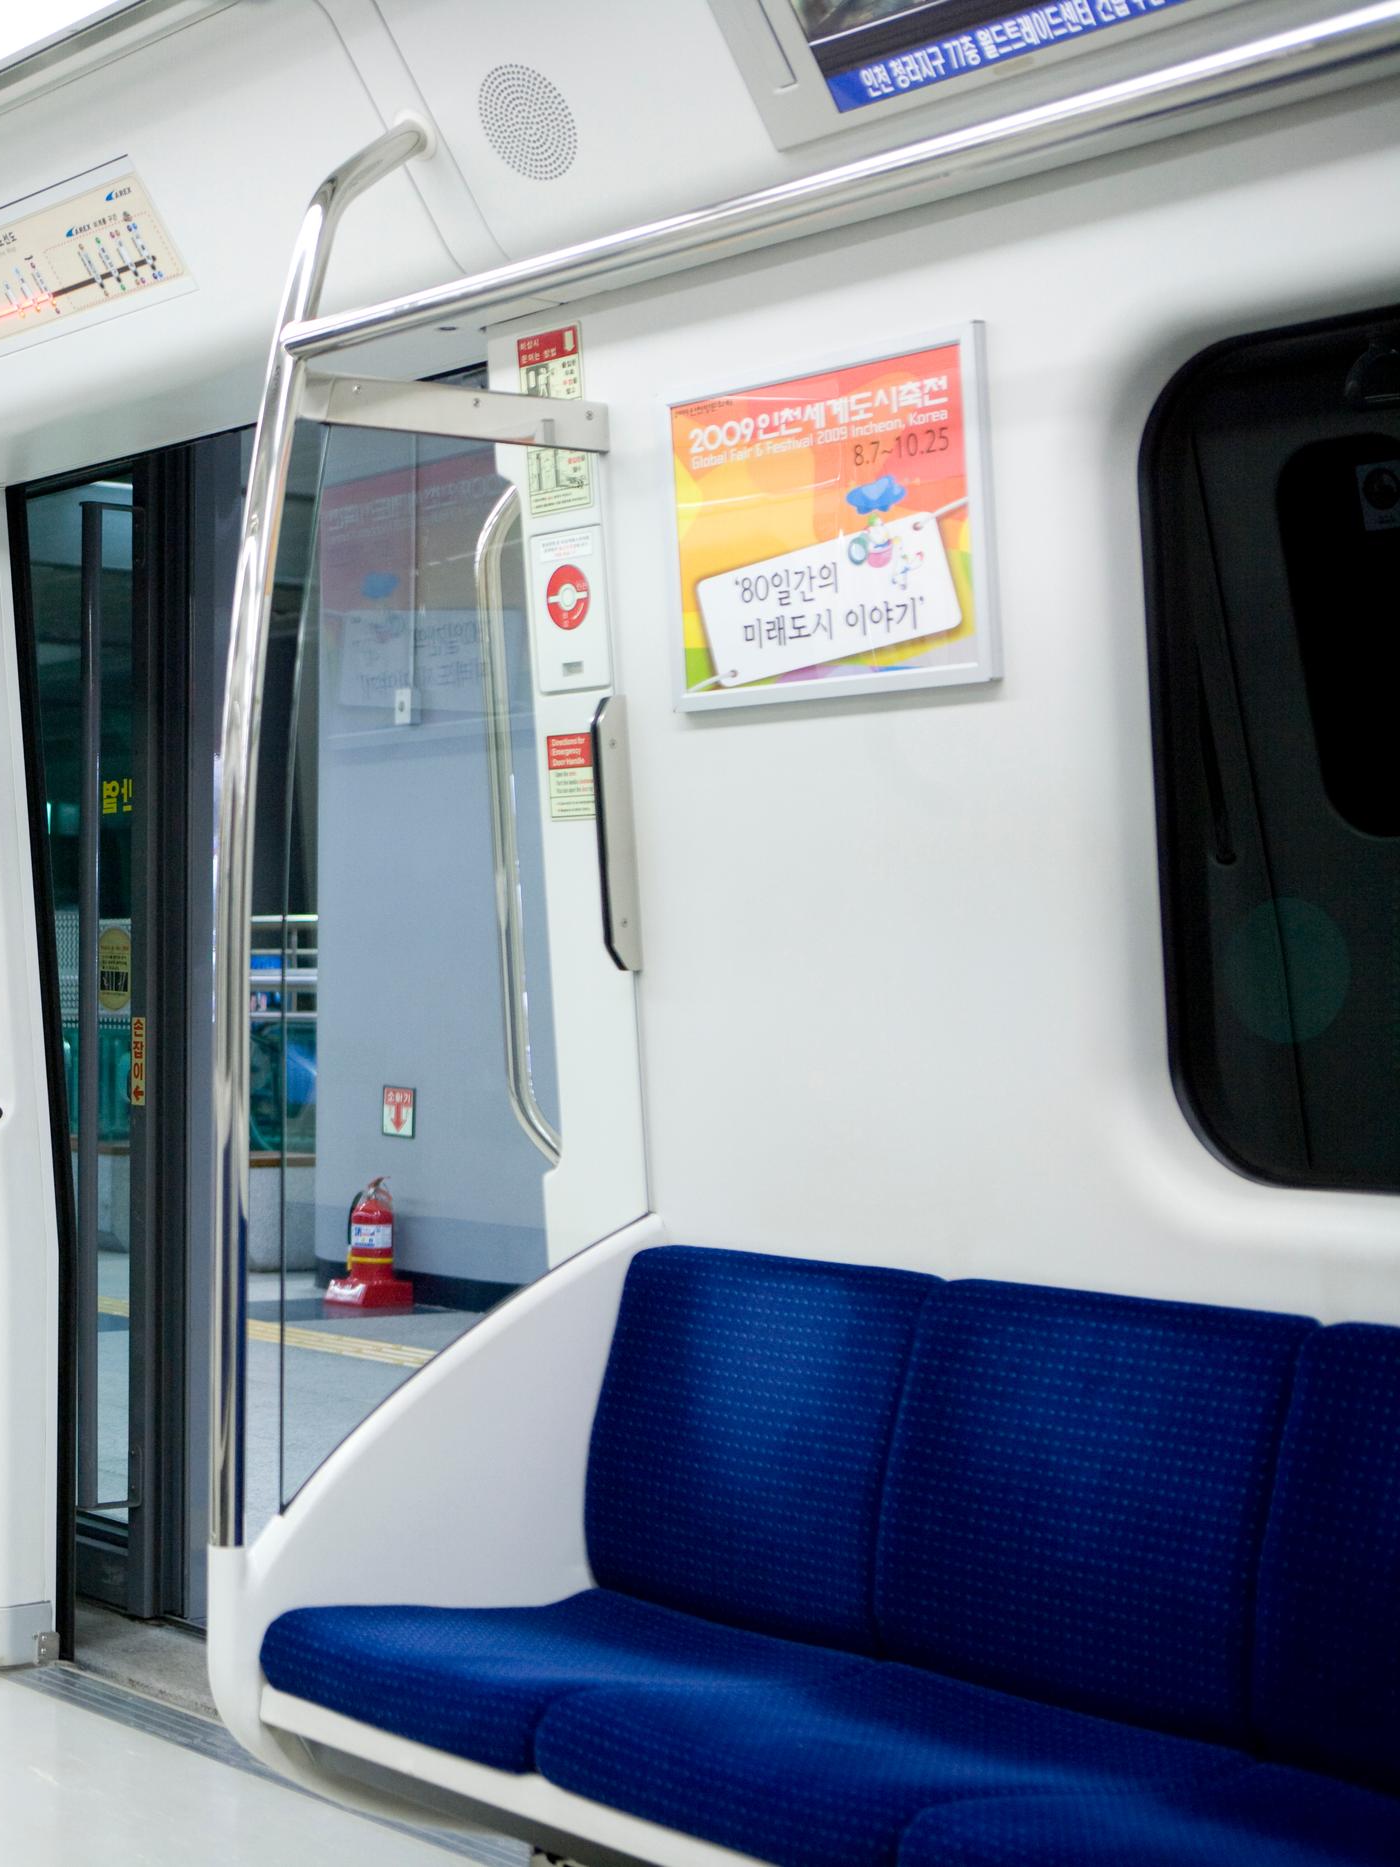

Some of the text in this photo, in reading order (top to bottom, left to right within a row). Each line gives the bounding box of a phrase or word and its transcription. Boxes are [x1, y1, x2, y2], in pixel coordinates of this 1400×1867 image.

[859, 63, 895, 98] 인천
[888, 46, 946, 88] 청라지구
[941, 35, 981, 69] 77층
[975, 0, 1097, 60] 월드트레이드센터
[689, 375, 949, 454] 2009인천세계도시축전
[692, 449, 728, 470] Global
[730, 445, 752, 464] Fair
[766, 433, 814, 456] Festival
[817, 426, 848, 445] 2009
[909, 409, 948, 427] Korea
[853, 426, 950, 467] 8.7~10.25
[743, 608, 833, 649] 미래도시
[133, 1018, 144, 1081] 손잡이
